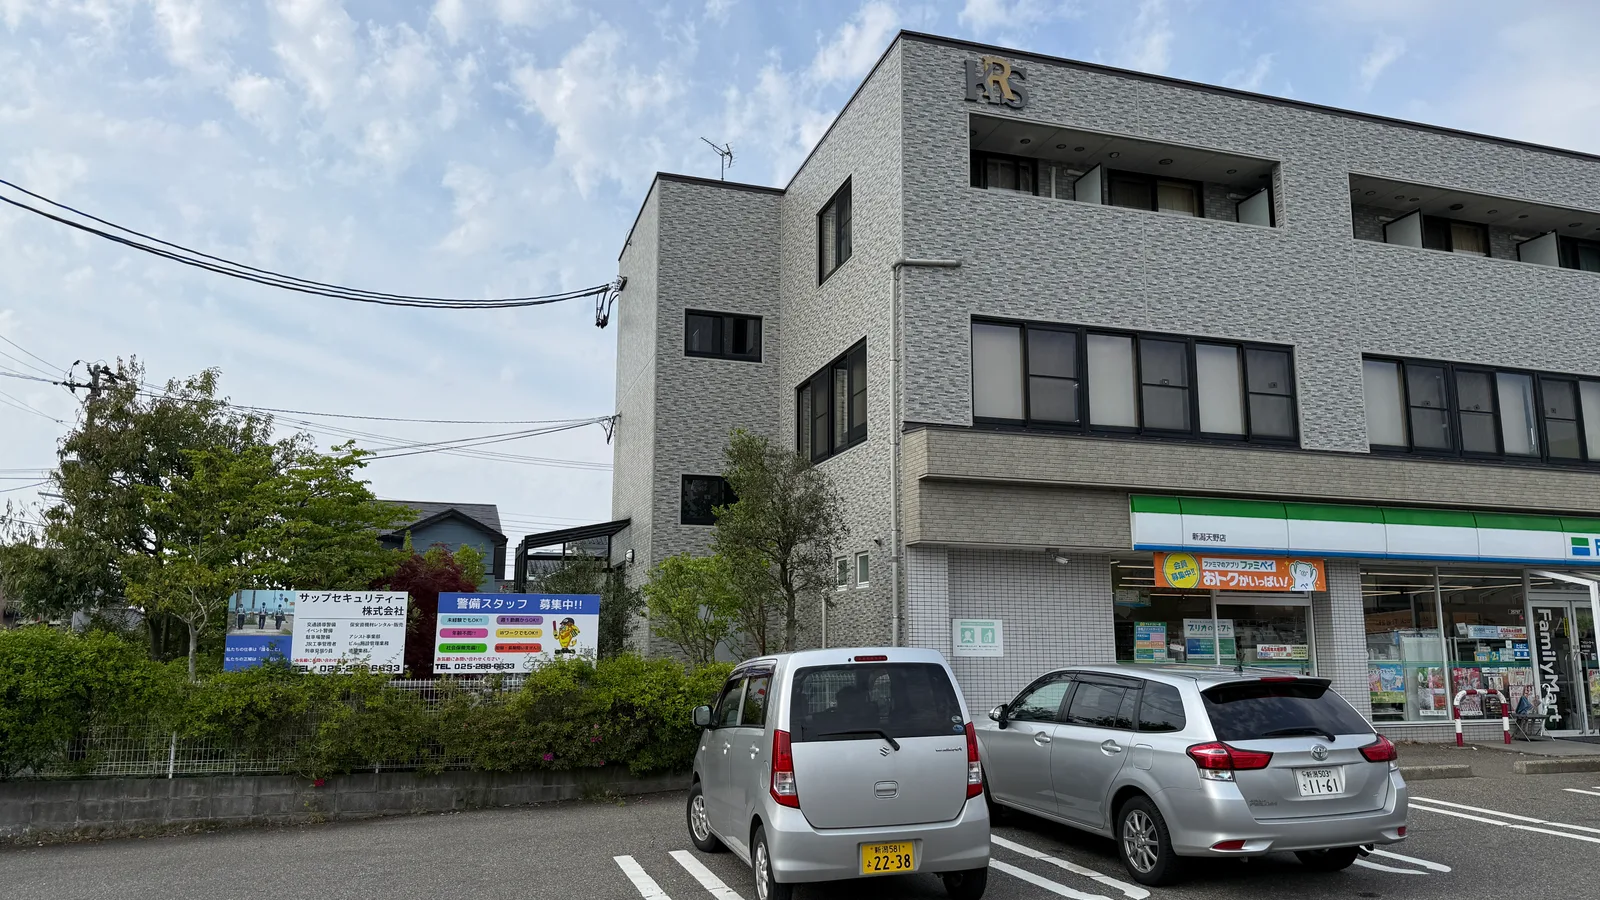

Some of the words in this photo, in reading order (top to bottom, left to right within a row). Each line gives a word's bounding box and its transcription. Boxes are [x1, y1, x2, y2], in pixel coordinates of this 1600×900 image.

[1192, 533, 1226, 542] 新潟天野店
[1173, 561, 1188, 571] 会員
[1203, 560, 1239, 569] ファミマのアプリ
[1240, 560, 1274, 571] ファミペイ
[1203, 571, 1288, 587] おトクがいっぱい!
[299, 592, 404, 604] サップセキュリティー
[457, 597, 527, 609] 警備スタッフ
[539, 599, 582, 610] 募集中!!
[362, 605, 404, 616] 株式会社
[1536, 608, 1568, 723] FamilyMart
[1309, 778, 1339, 794] 11-61
[874, 853, 911, 871] 22-38
